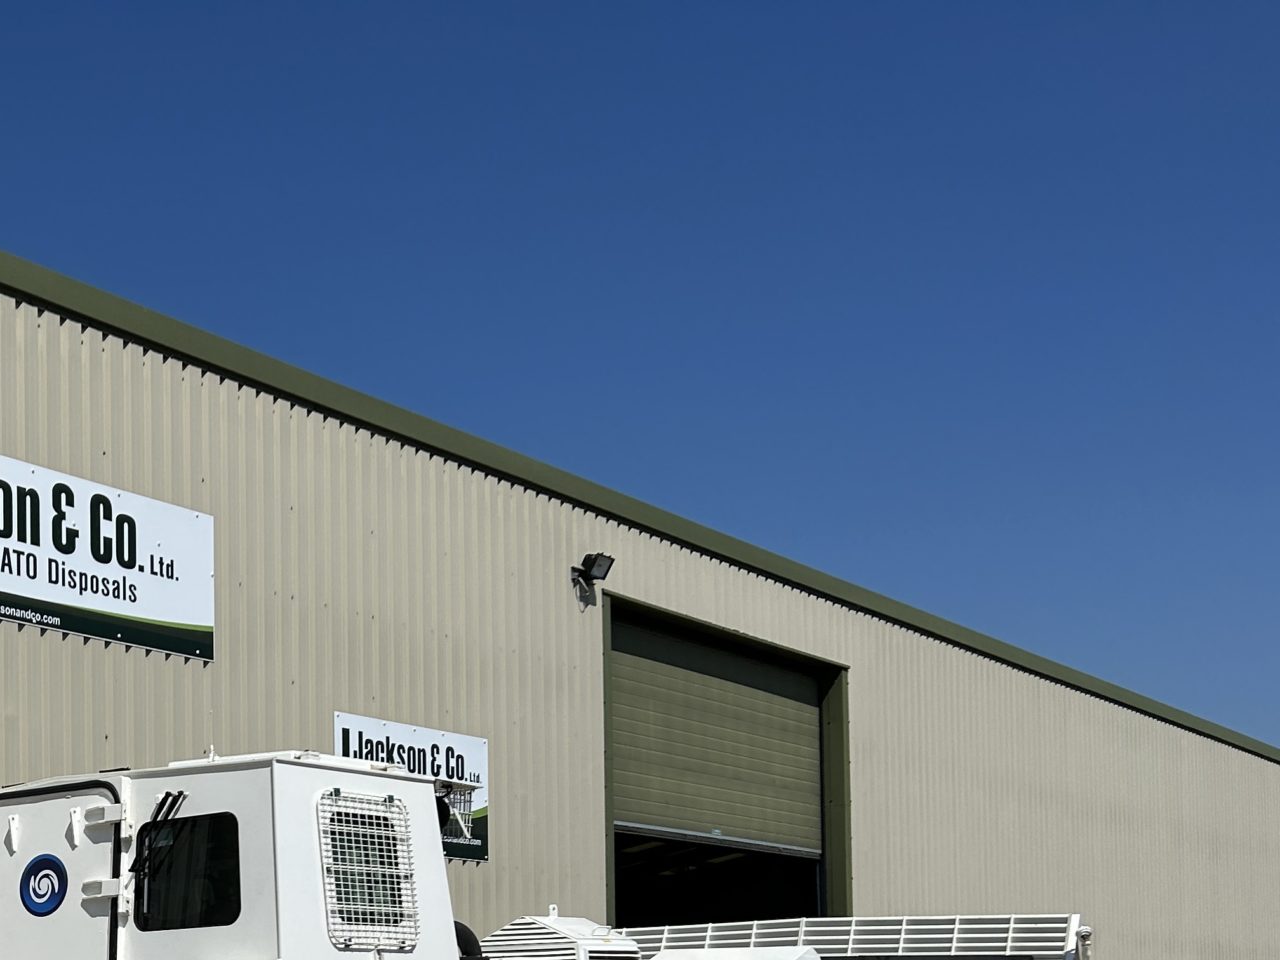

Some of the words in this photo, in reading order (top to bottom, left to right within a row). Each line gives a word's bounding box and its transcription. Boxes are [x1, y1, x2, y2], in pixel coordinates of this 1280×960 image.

[52, 483, 79, 554] &
[90, 494, 145, 573] Co.
[149, 555, 180, 582] Ltd.
[47, 558, 138, 603] Disposals
[431, 744, 442, 778] &
[445, 746, 468, 782] Co.
